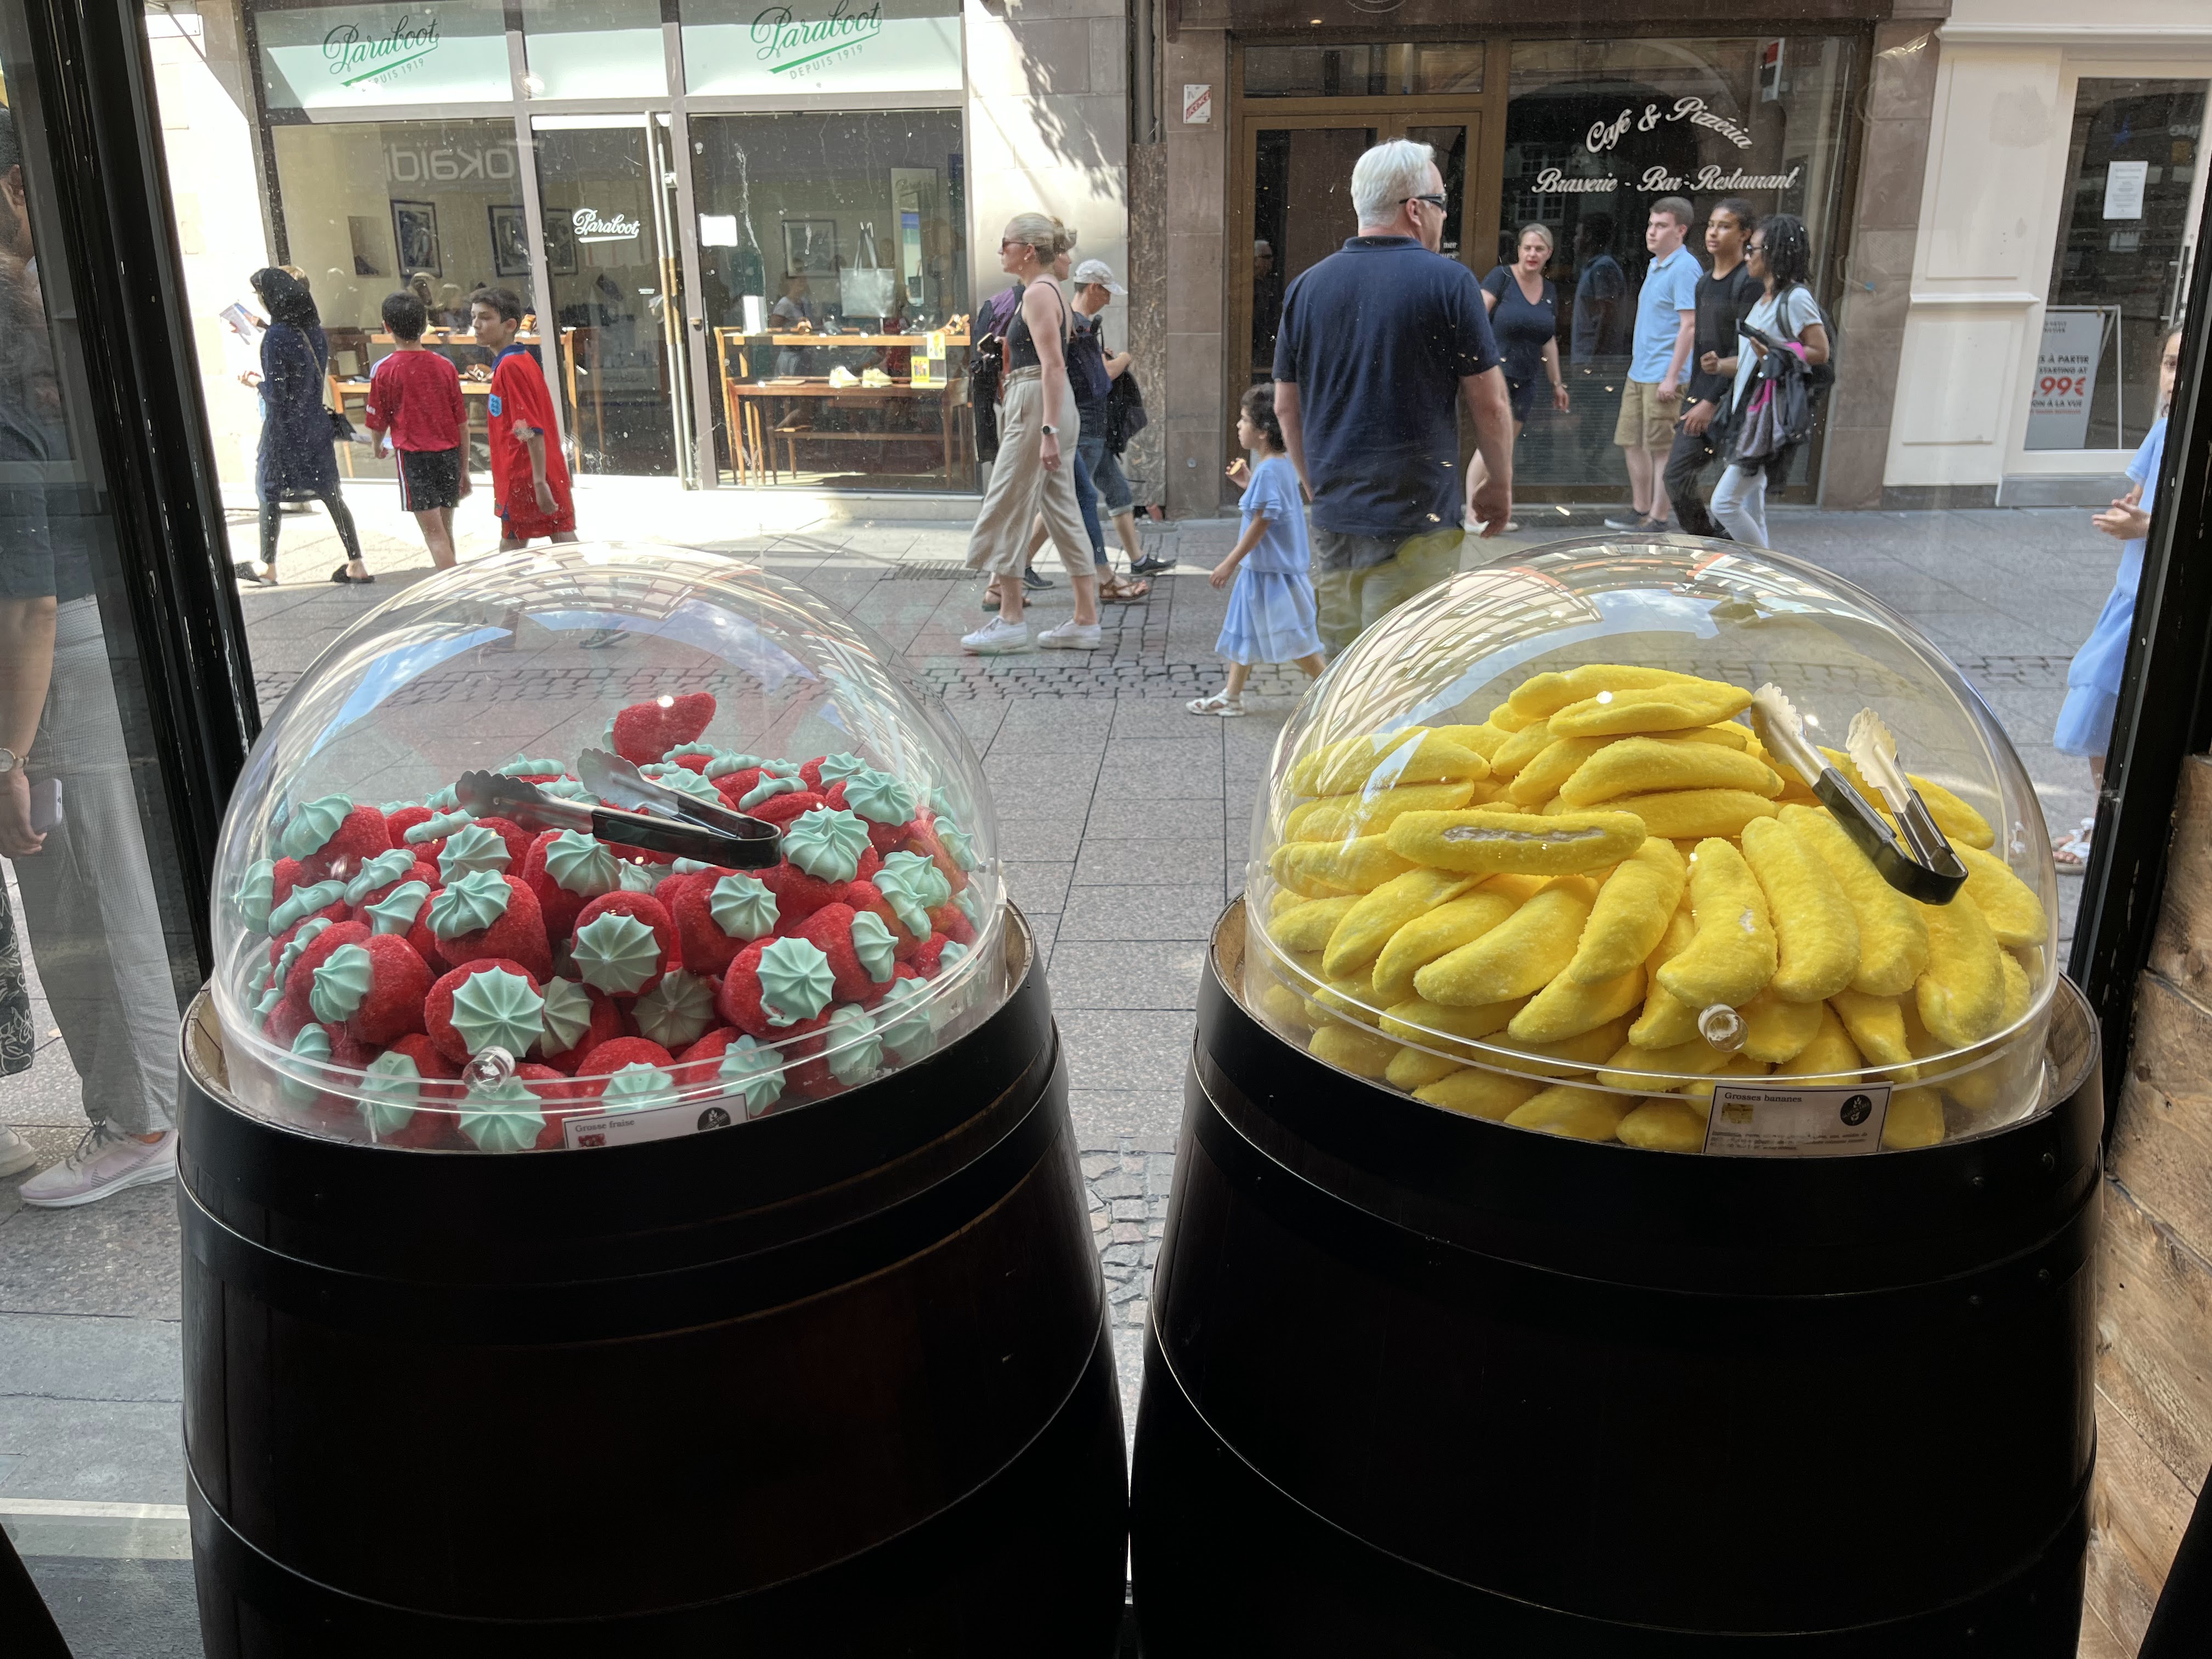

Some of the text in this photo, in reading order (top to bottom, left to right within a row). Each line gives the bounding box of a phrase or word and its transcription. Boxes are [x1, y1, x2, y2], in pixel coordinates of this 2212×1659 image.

[751, 0, 882, 60] Paraboot
[323, 15, 439, 75] Paraboot
[400, 58, 424, 75] 1919
[789, 44, 863, 80] DEPUIS 1919
[1638, 104, 1662, 132] &
[1531, 167, 1618, 193] Brasserie
[573, 208, 641, 235] Paraboot
[2057, 354, 2089, 364] PARTIR
[1724, 1092, 1802, 1103] Grosses bananes
[575, 1119, 635, 1133] Grosse fraise
